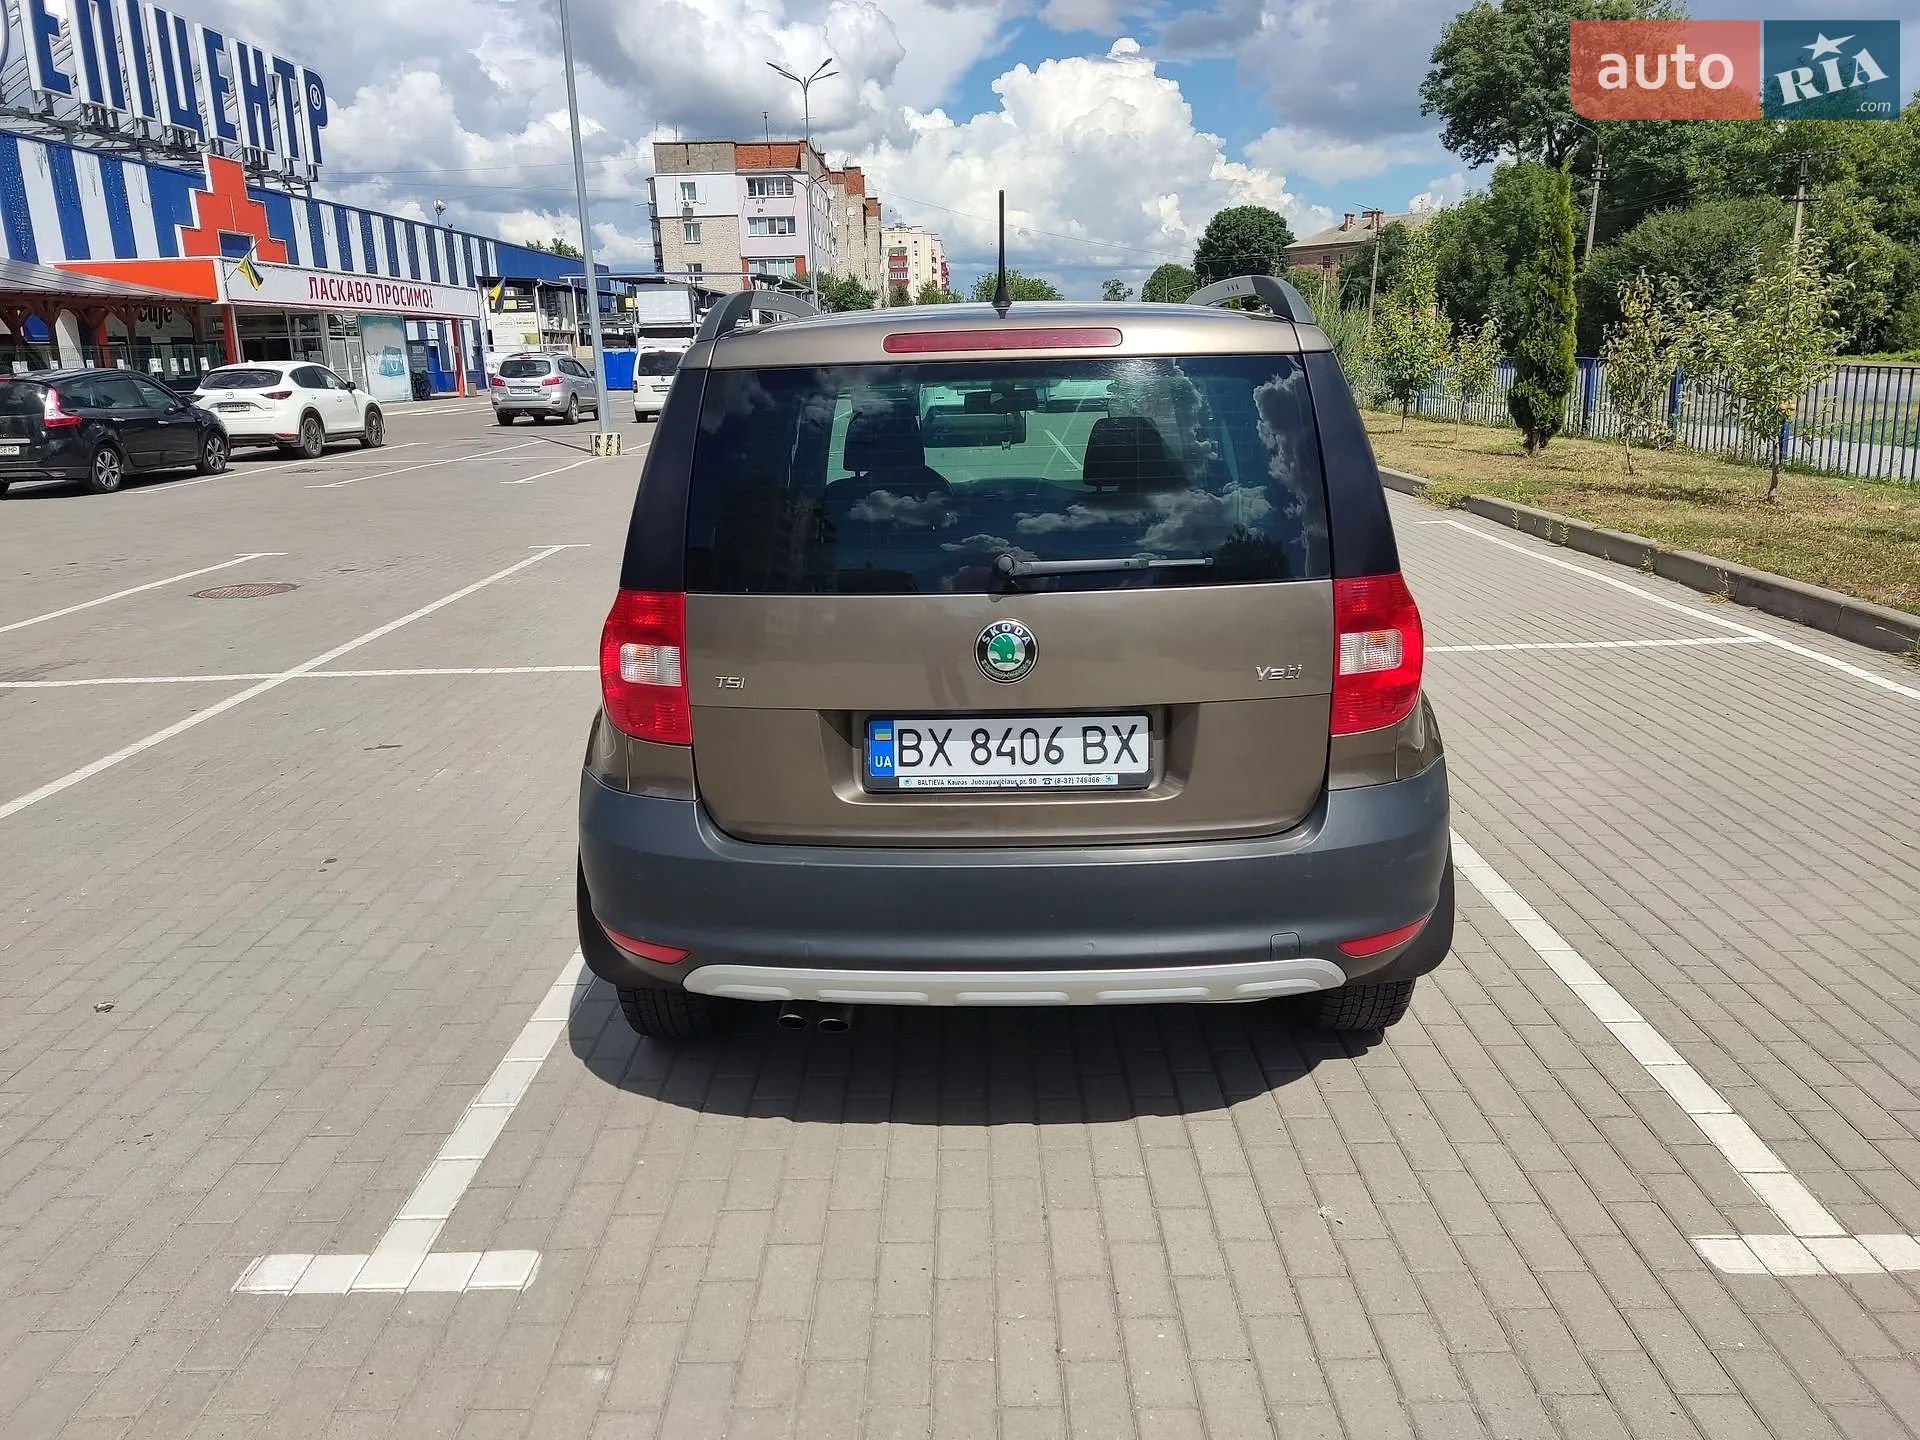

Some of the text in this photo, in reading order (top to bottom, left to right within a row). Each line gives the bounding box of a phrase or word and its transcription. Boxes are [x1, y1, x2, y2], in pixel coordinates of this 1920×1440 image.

[308, 276, 434, 309] ЛАСКАВО ПРОСИМО!
[715, 676, 745, 689] TSI
[898, 724, 1139, 767] BX 8406 BX
[875, 756, 892, 768] UA
[917, 778, 945, 786] BALTIEVA
[947, 778, 968, 786] Kaunas
